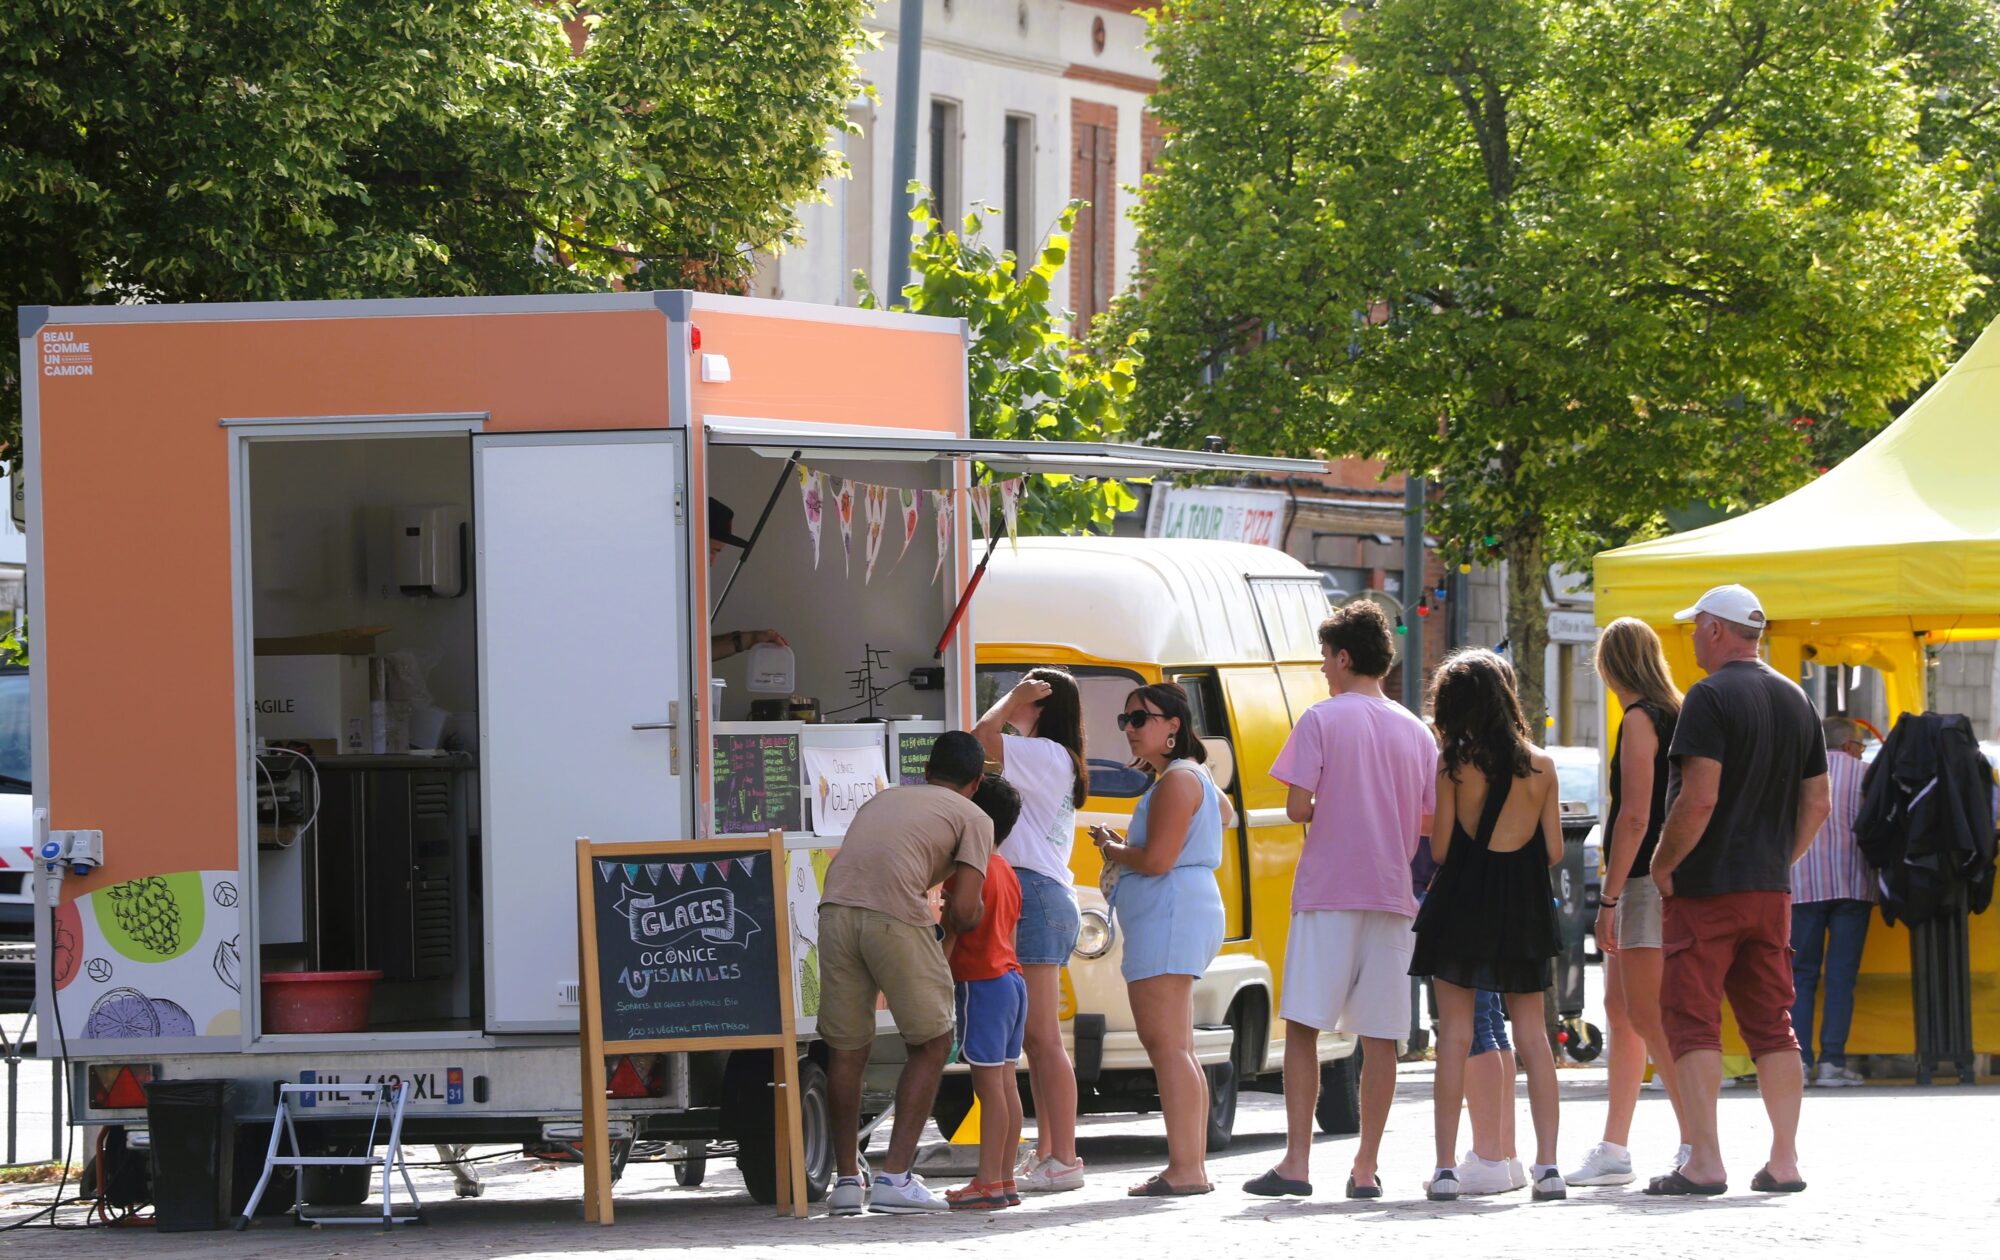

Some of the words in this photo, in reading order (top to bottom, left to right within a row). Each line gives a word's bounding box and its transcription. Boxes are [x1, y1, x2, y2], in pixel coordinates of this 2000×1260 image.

[43, 331, 74, 342] BEAU
[43, 342, 90, 353] COMME
[44, 354, 61, 365] UN
[44, 365, 93, 376] CAMION
[1165, 502, 1186, 538] LA
[1188, 504, 1224, 539] TOUR
[831, 782, 874, 811] GLACES
[640, 898, 727, 937] GLACES
[627, 1026, 646, 1039] 100
[692, 1022, 702, 1032] ET
[304, 1091, 311, 1100] F
[413, 1073, 445, 1099] XL
[449, 1088, 462, 1100] 31
